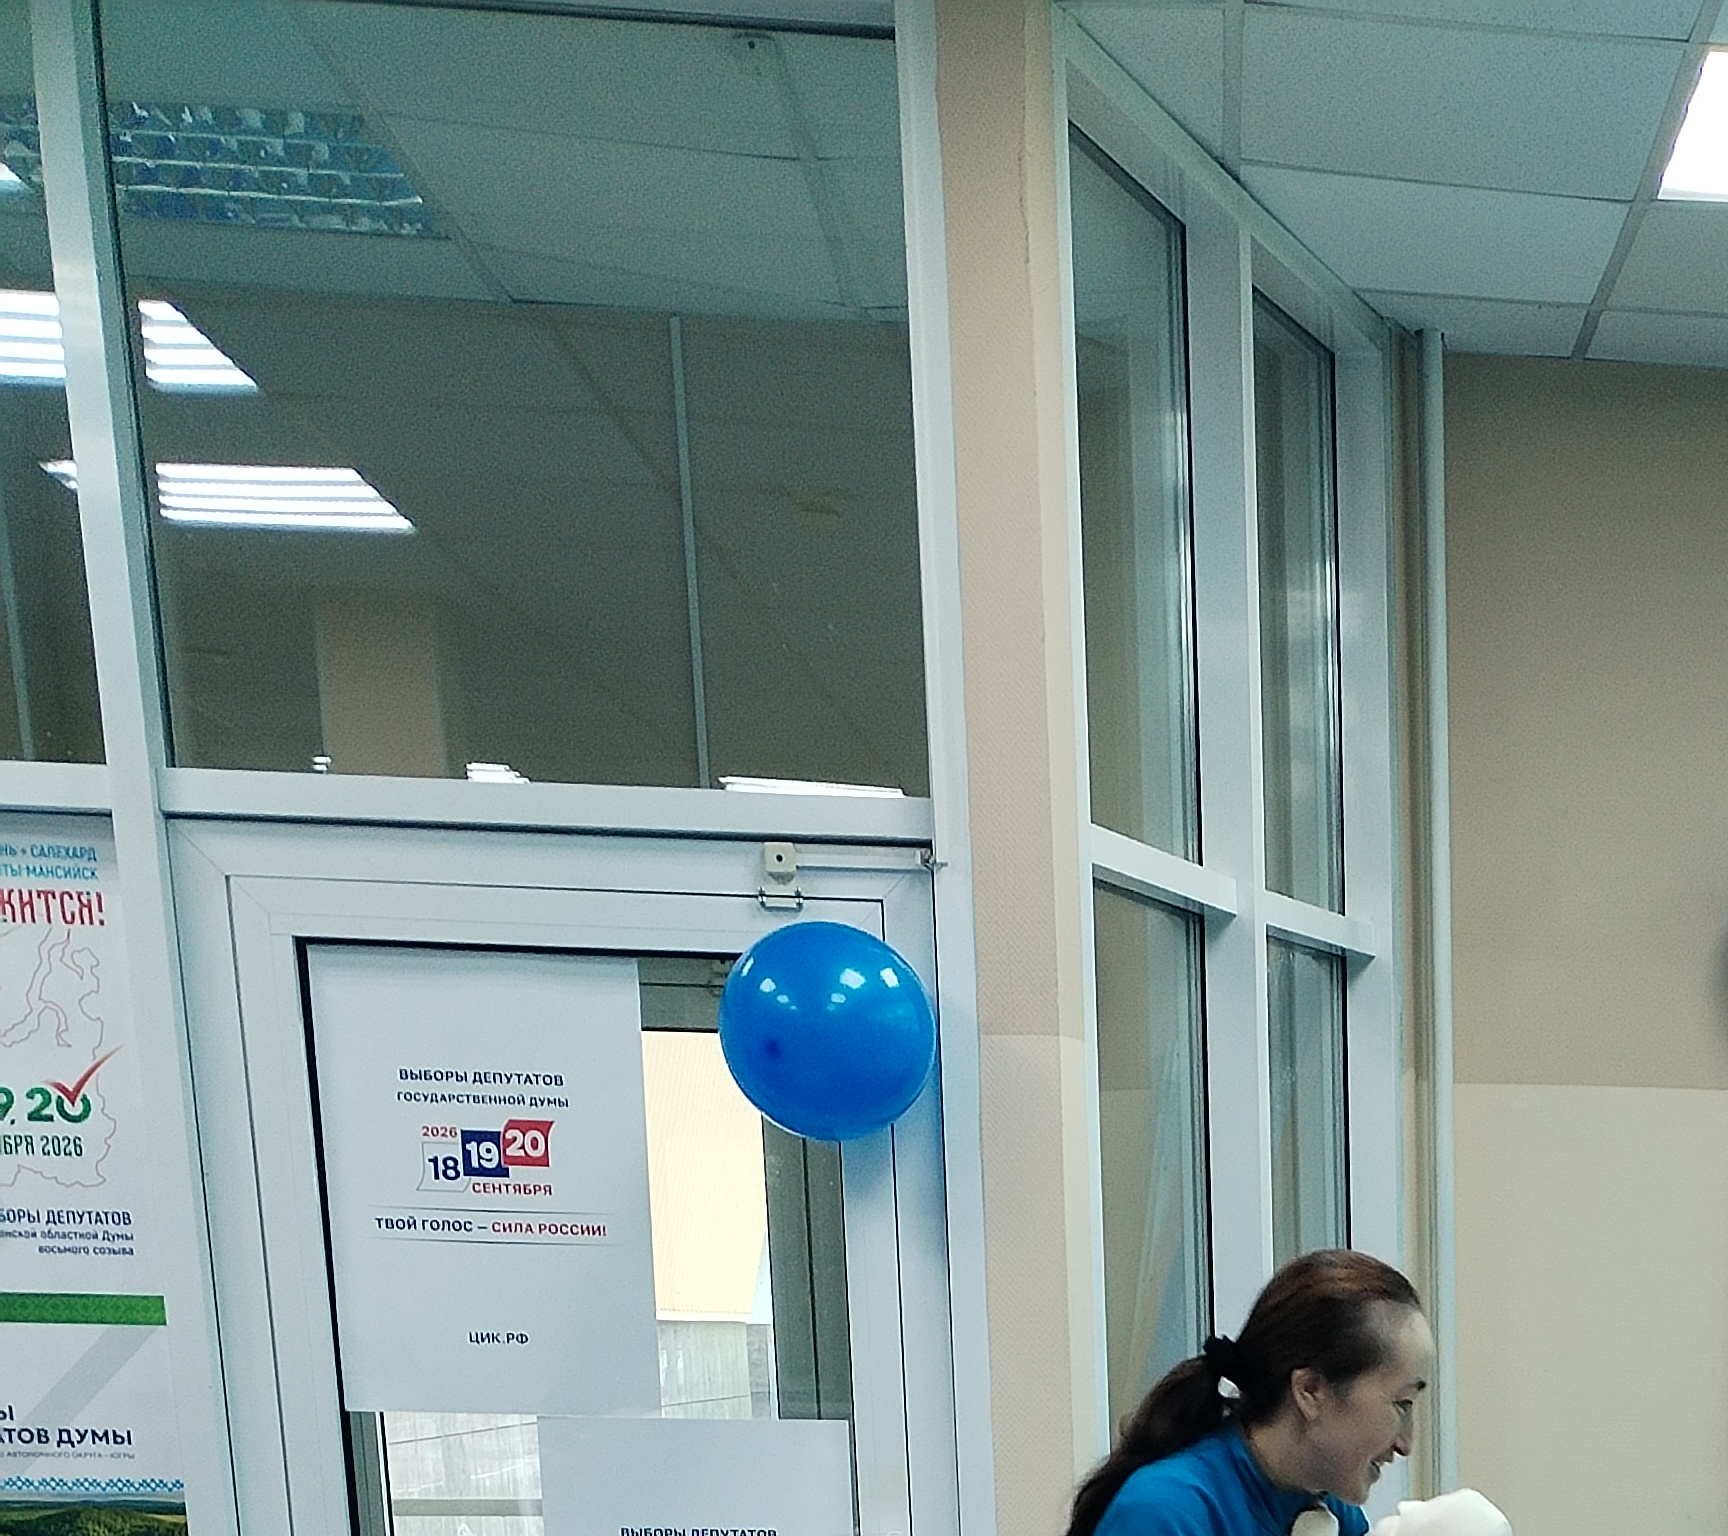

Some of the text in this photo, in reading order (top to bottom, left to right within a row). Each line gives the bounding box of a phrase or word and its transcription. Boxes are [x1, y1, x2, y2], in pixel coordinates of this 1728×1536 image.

[30, 844, 97, 862] САЛЕХАРД
[399, 1068, 564, 1088] ВЫБОРЫ ДЕПУТАТОВ
[26, 1086, 92, 1123] 20
[396, 1090, 570, 1109] ГОСУДАРСТВЕННОЙ ДУМЫ
[421, 1125, 458, 1139] 2026
[40, 1135, 83, 1157] 2026
[428, 1129, 544, 1181] 18 19 20
[471, 1182, 554, 1197] СЕНТЯБРЯ
[46, 1209, 131, 1226] ДЕПУТАТОВ
[374, 1214, 417, 1231] ТВОЙ
[421, 1218, 473, 1232] ГОЛОС
[491, 1220, 534, 1235] СИЛА
[538, 1223, 607, 1237] РОССИИ!
[40, 1230, 98, 1240] областной
[102, 1231, 133, 1242] Думы
[38, 1246, 133, 1255] восьмого созыва
[468, 1330, 529, 1346] ЦИК.РФ
[56, 1429, 132, 1448] ДУМЫ
